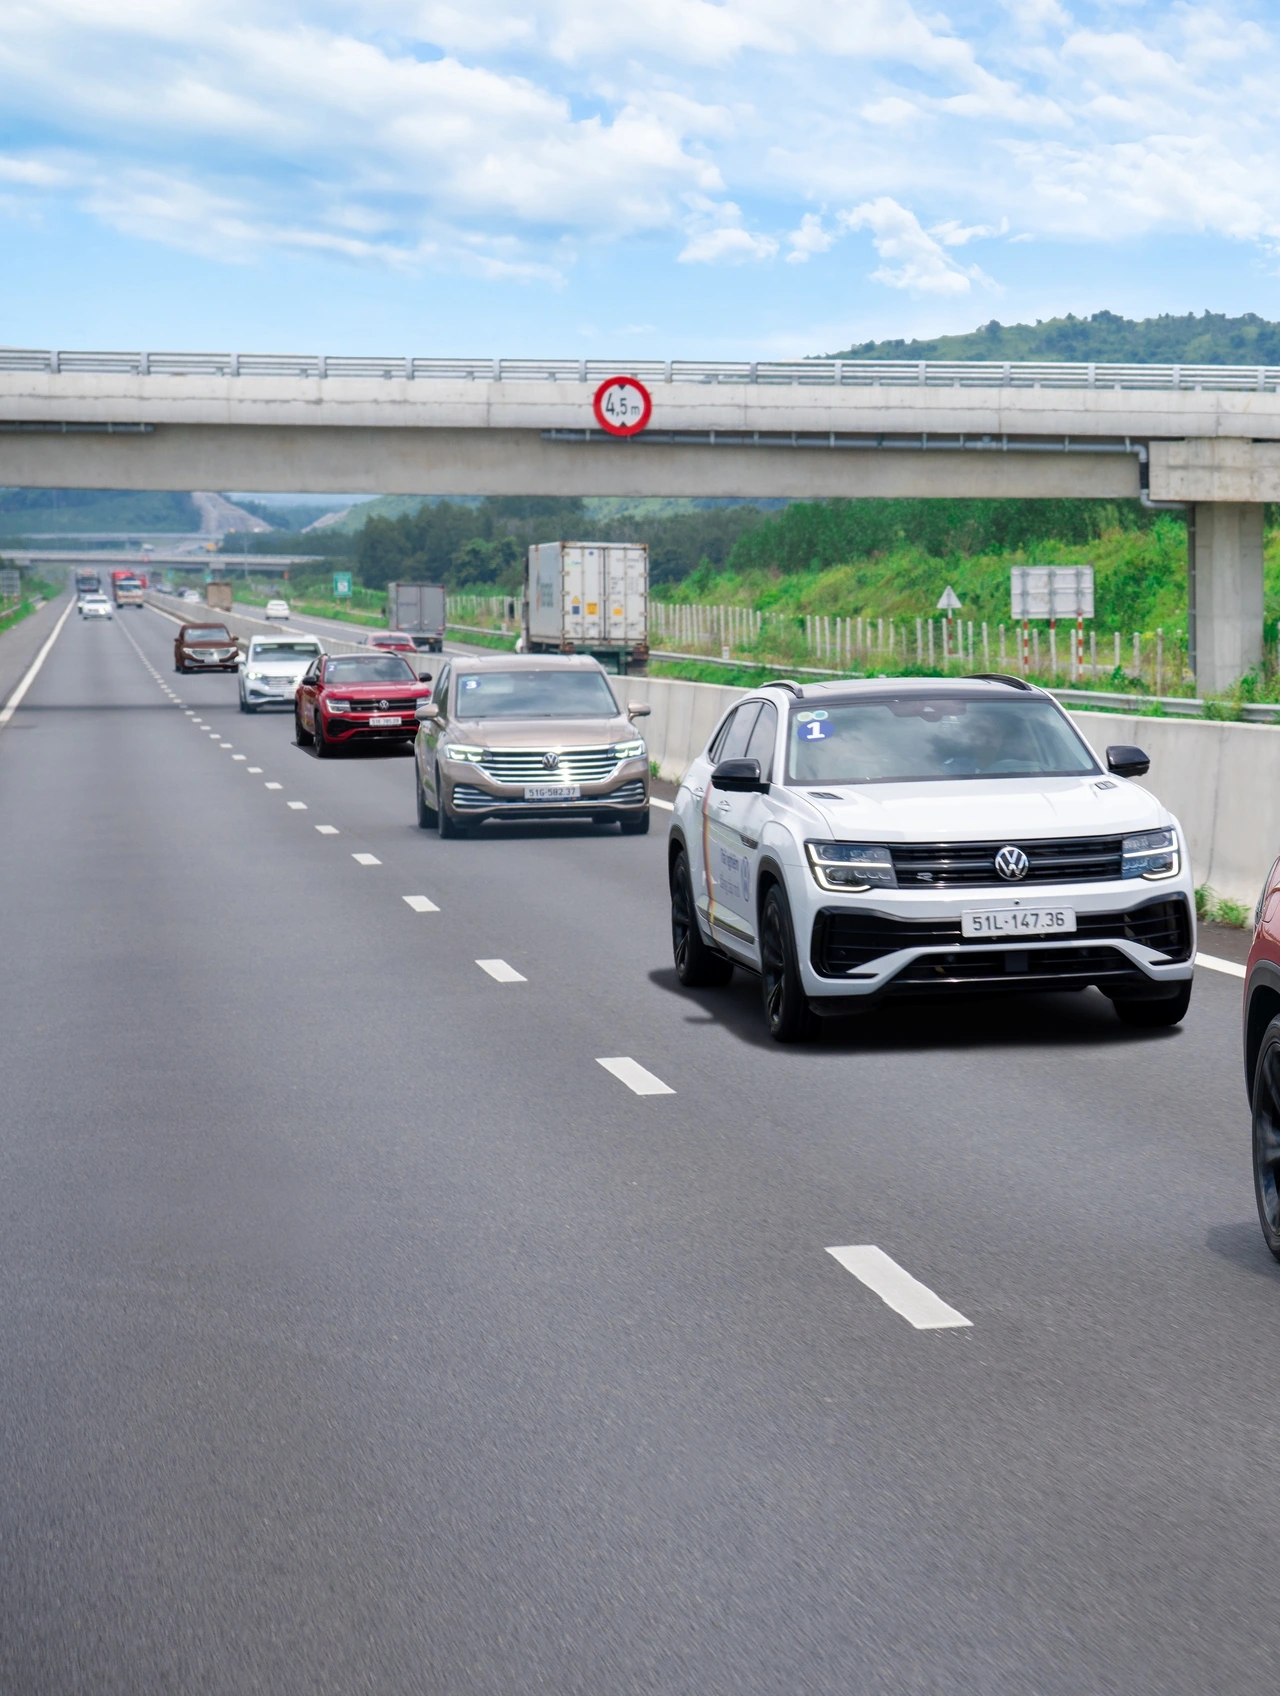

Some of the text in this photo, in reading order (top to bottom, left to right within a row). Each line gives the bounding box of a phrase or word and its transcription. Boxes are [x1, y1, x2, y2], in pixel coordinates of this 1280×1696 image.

[605, 392, 627, 417] 4,5
[466, 680, 477, 689] 3
[806, 721, 825, 739] 1
[528, 787, 576, 797] 51G-582.37
[995, 846, 1029, 881] VW
[972, 911, 1066, 932] 51L-147.36
